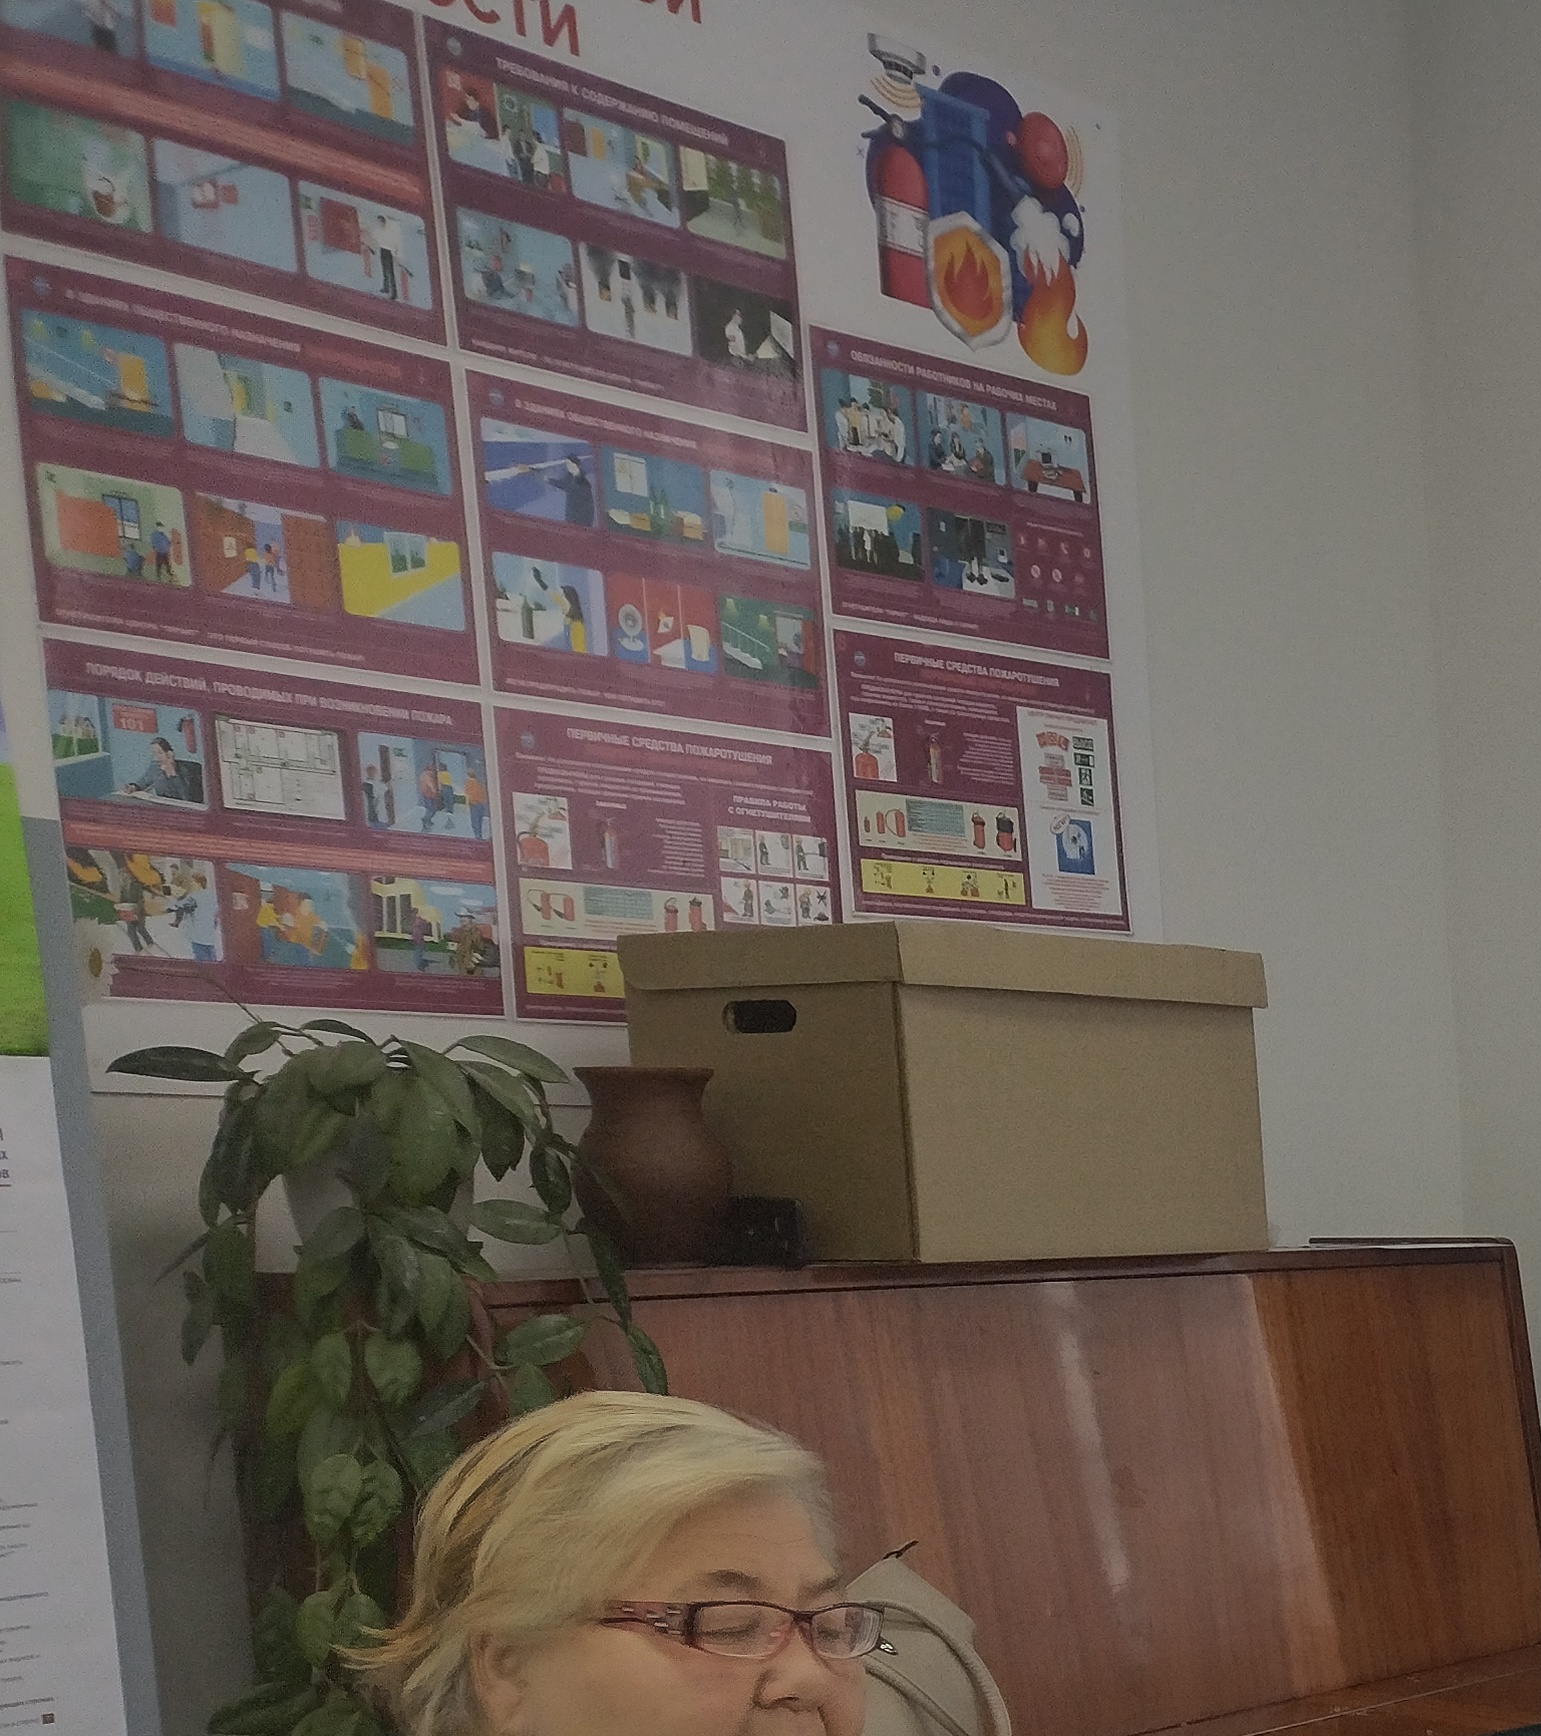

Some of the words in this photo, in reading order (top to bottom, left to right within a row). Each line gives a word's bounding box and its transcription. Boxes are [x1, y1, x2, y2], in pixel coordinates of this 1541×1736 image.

[496, 57, 569, 94] ТРЕБОВАНИЯ
[581, 85, 659, 122] СОДЕРЖАНИЮ
[660, 111, 730, 147] ПОМЕЩЕНИЙ
[850, 349, 915, 375] ОБЯЗАННОСТИ
[916, 366, 971, 390] РАБОТНИКОВ
[973, 380, 986, 392] НА
[986, 383, 1024, 402] РАБОЧИХ
[1025, 394, 1057, 411] МЕСТАХ
[894, 652, 945, 670] ПЕРВИЧНЫЕ
[946, 660, 988, 676] СРЕДСТВА
[989, 666, 1059, 688] ПОЖАРОТУШЕНИЯ
[85, 662, 142, 685] ПОРЯДОК
[213, 681, 293, 704] ПРОВОДИМЫХ
[295, 692, 317, 707] ПРИ
[411, 709, 453, 726] ПОЖАРА
[120, 718, 145, 732] 101
[567, 727, 630, 747] ПЕРВИЧНЫЕ
[632, 736, 684, 754] СРЕДСТВА
[685, 743, 774, 765] ПОЖАРОТУШЕНИЯ
[733, 795, 772, 810] ПРАВИЛА
[773, 799, 808, 812] РАБОТЫ
[735, 806, 811, 823] ОГНЕТУШИТЕЛЯМИ
